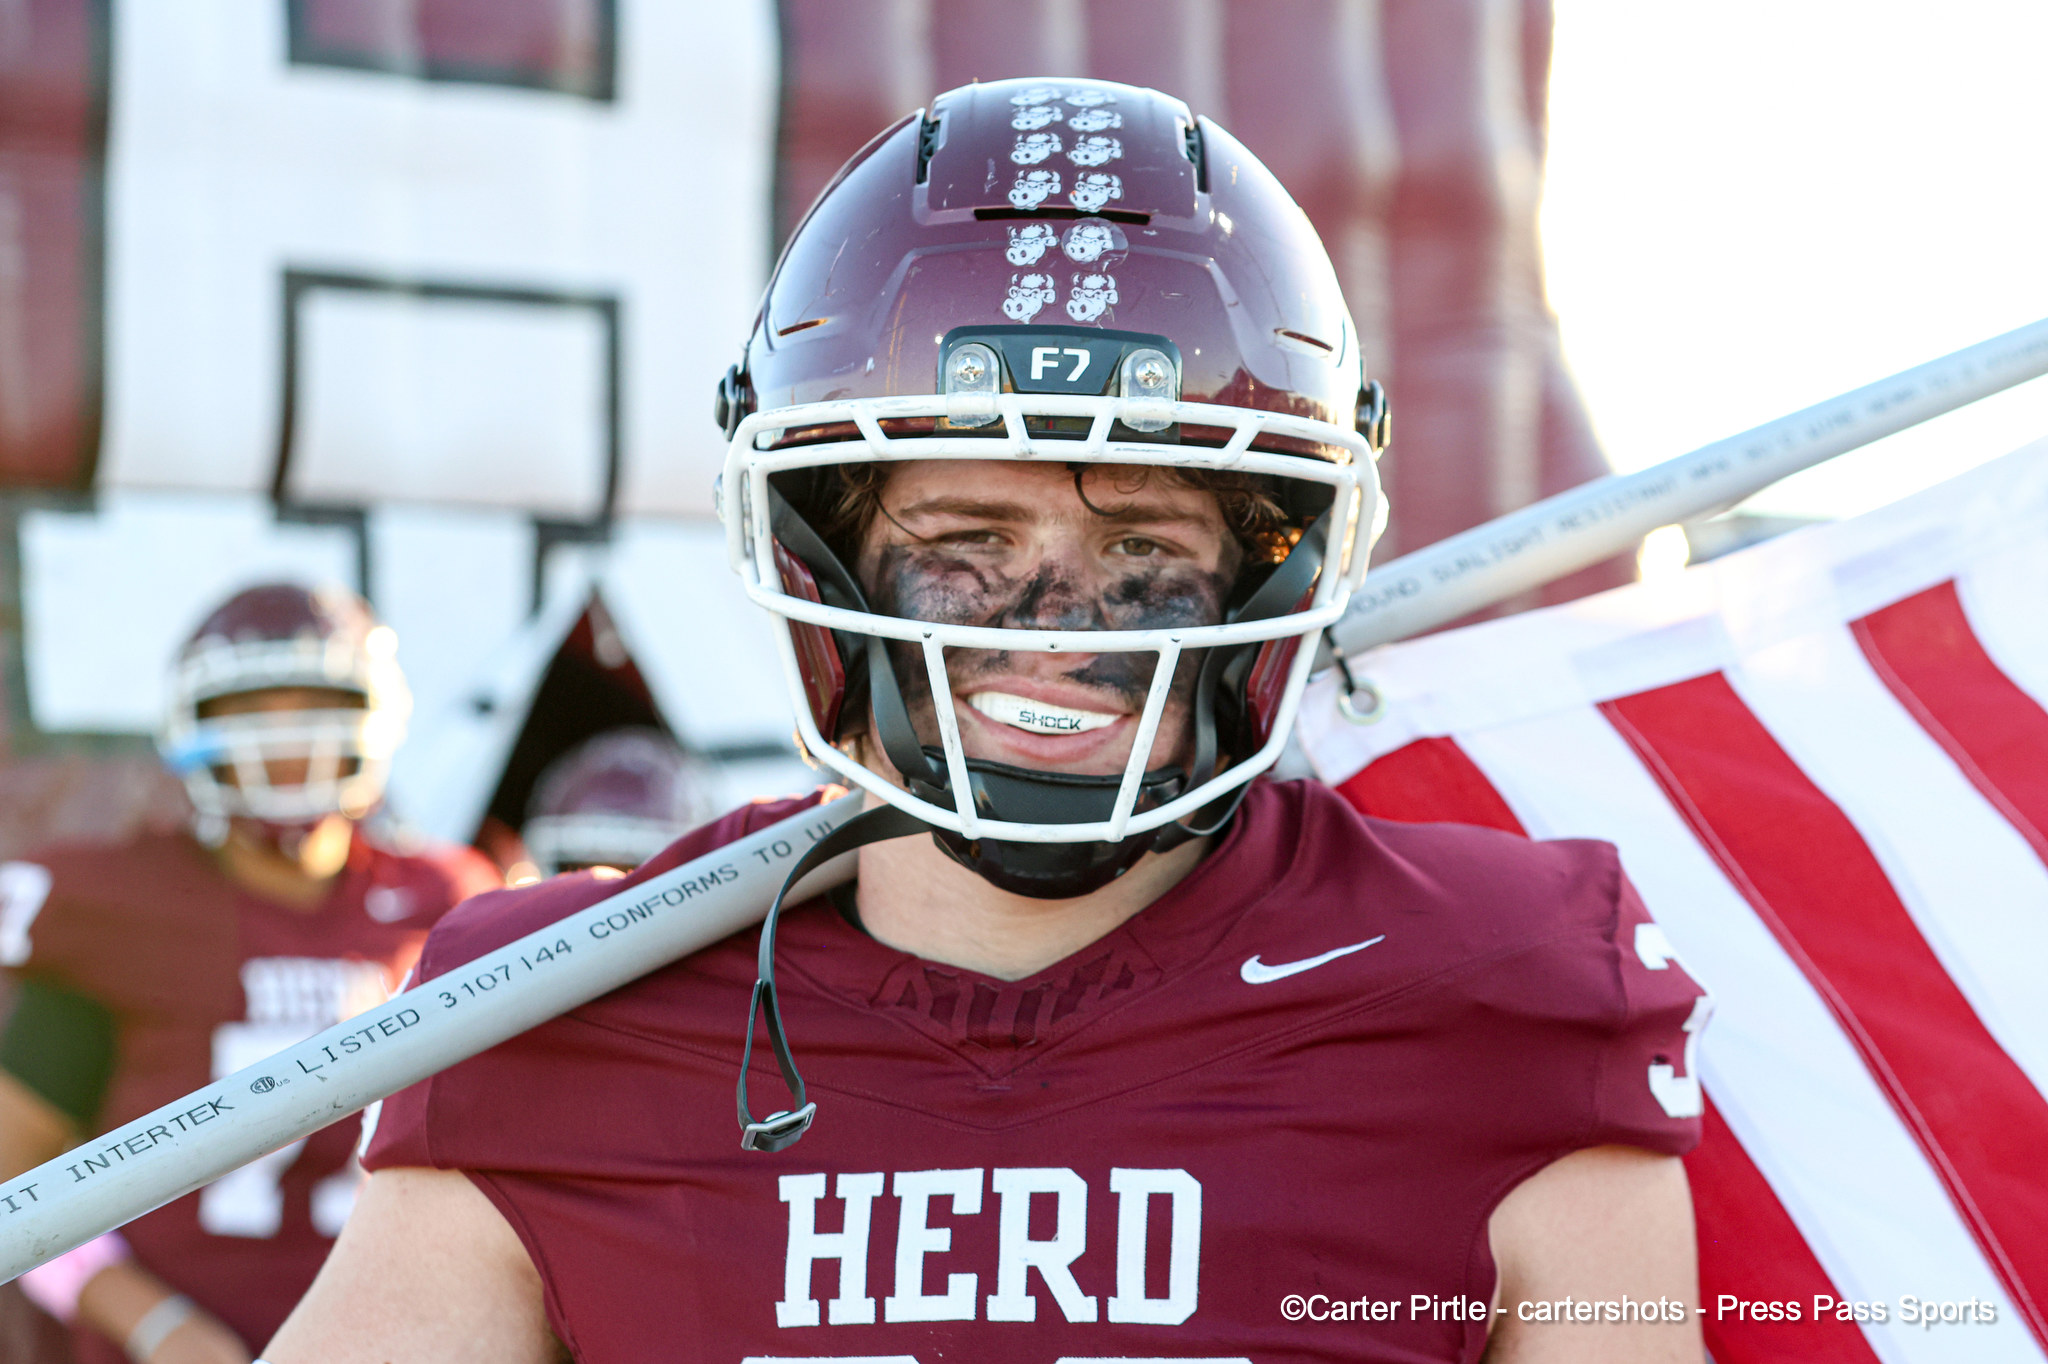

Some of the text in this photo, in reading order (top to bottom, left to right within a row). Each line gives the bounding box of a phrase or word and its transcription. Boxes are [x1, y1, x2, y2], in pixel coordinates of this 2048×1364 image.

[1030, 346, 1091, 382] F7
[1019, 711, 1082, 731] SHOCK
[66, 1095, 236, 1183] INTERTEK
[296, 1009, 420, 1074] LISTED
[438, 938, 573, 1009] 3107144
[589, 863, 740, 940] CONFORMS
[752, 840, 793, 865] TO
[775, 1167, 1202, 1328] HERD
